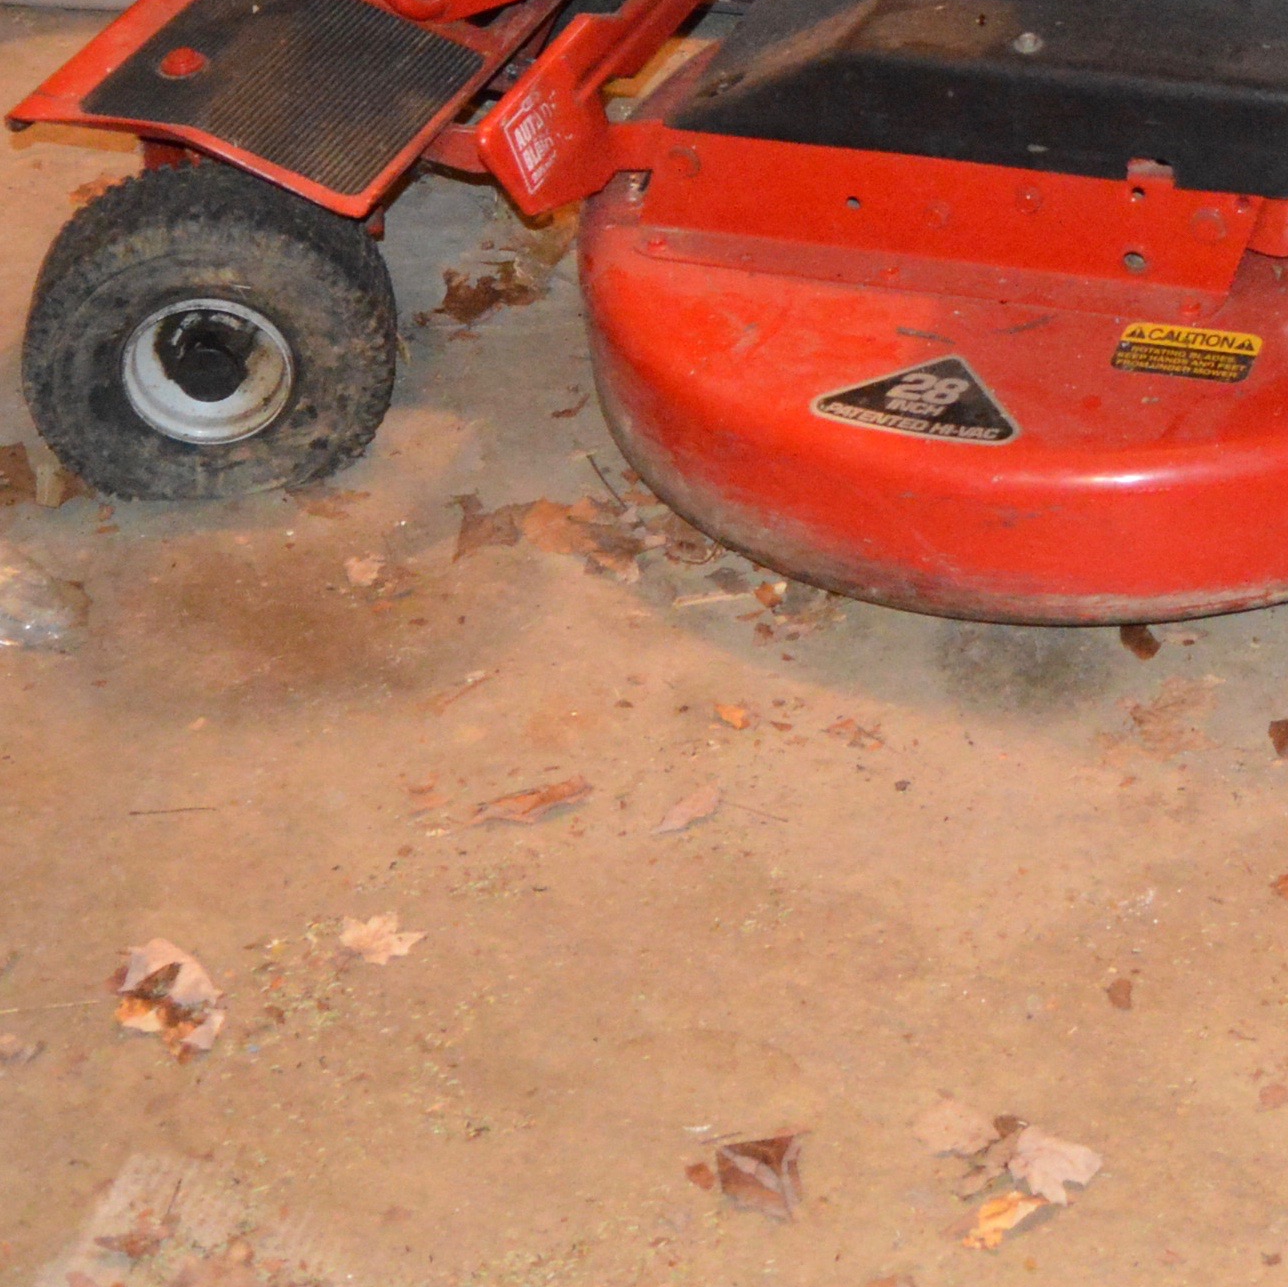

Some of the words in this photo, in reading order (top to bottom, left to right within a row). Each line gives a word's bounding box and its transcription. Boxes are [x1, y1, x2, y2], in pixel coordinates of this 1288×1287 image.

[1148, 327, 1237, 350] CAUTION
[885, 372, 970, 405] 28
[825, 402, 929, 432] PATENTED
[929, 421, 1000, 440] HI-VAC
[884, 398, 948, 417] INCH
